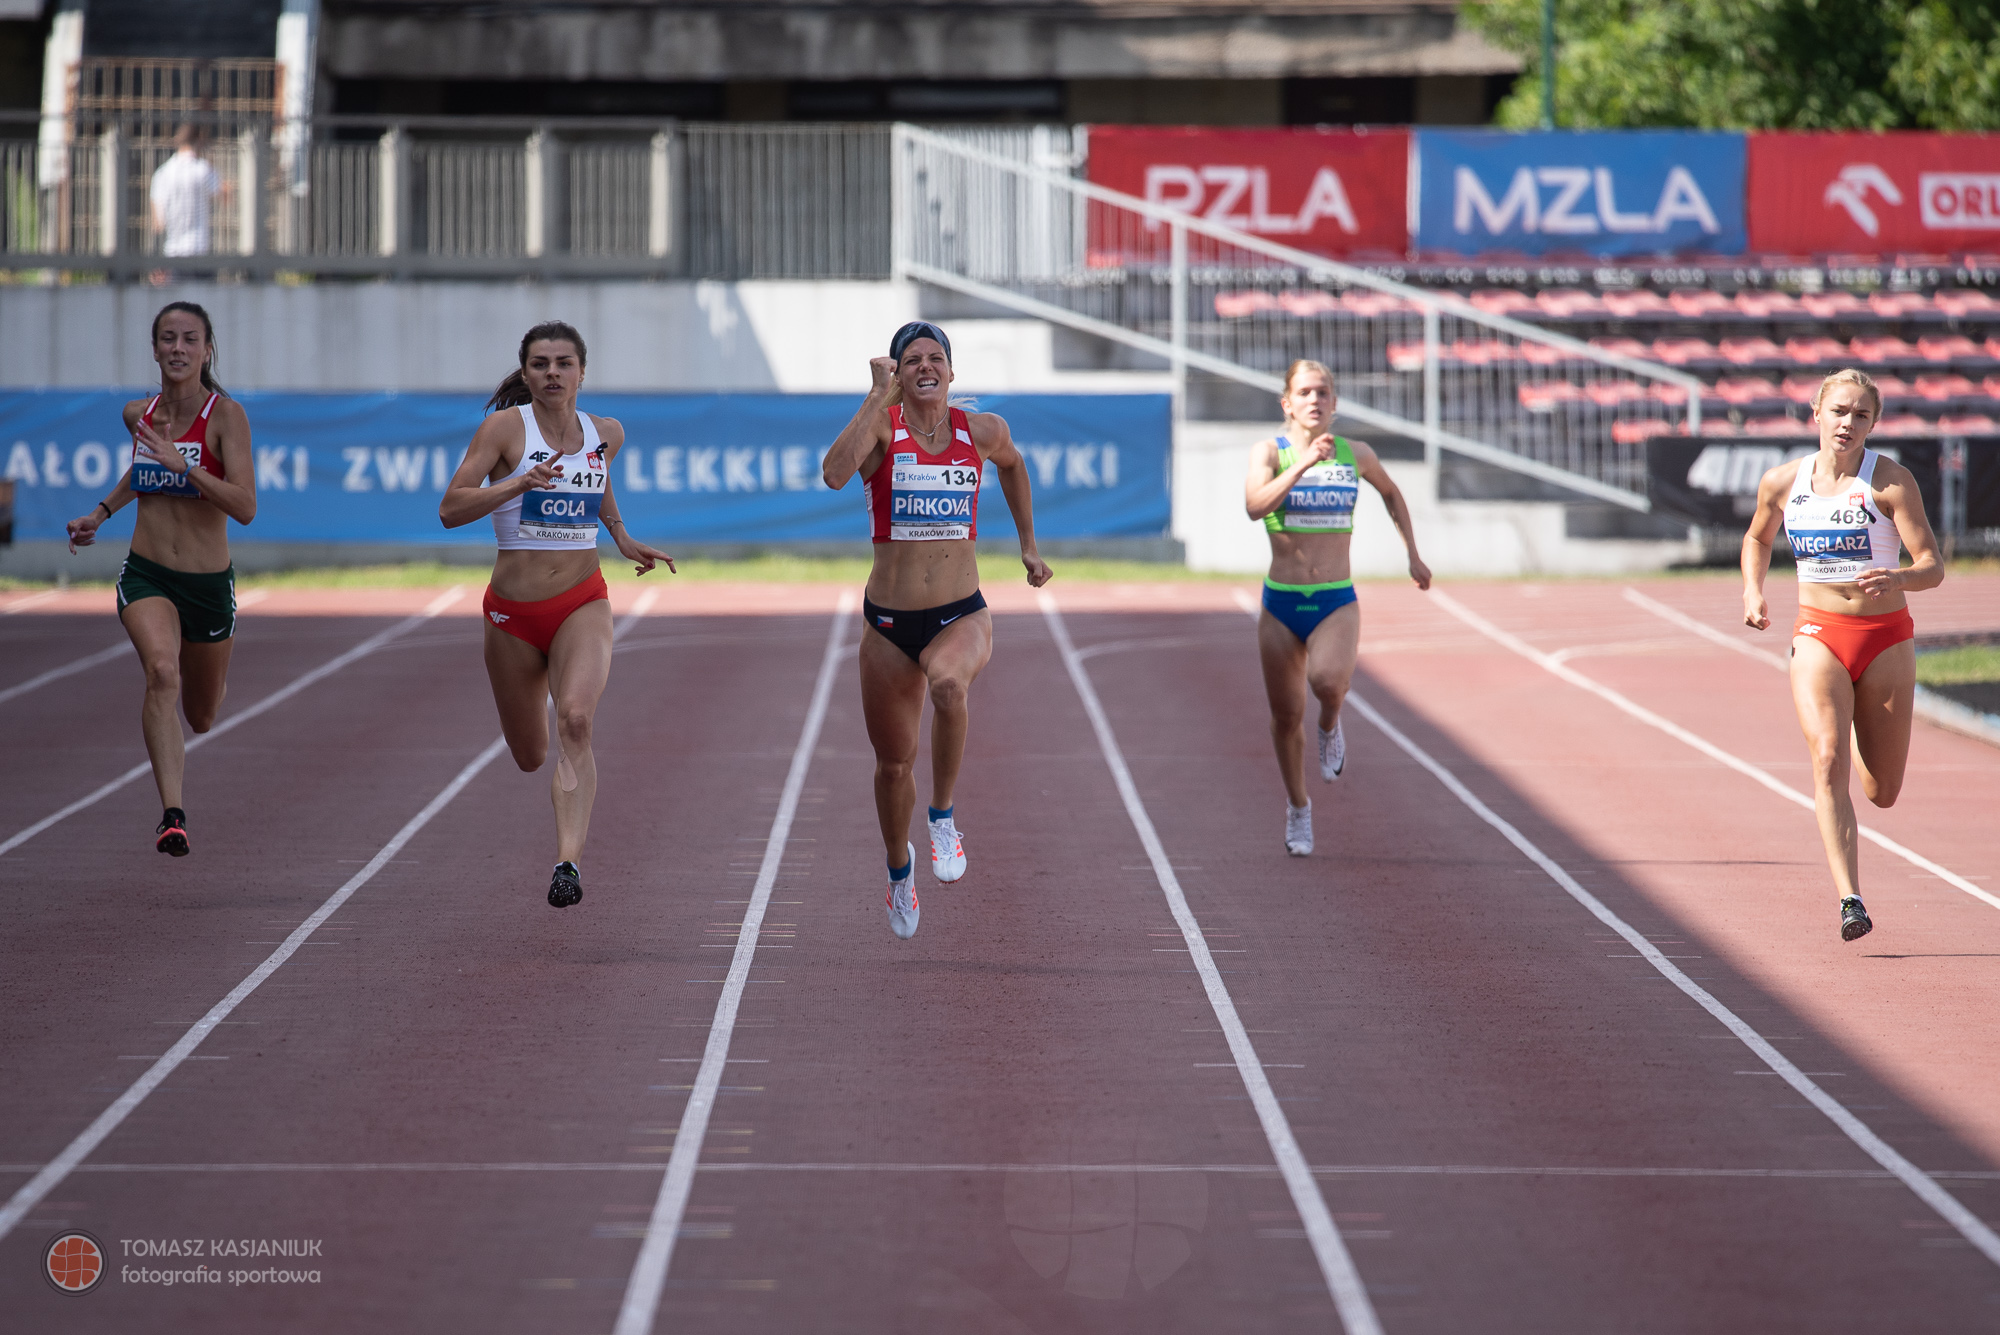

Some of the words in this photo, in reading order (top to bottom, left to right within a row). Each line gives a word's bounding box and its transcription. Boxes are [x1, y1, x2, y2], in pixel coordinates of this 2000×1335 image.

[1144, 165, 1360, 234] PZLA
[1453, 164, 1720, 235] MZLA
[528, 451, 549, 462] 4F
[138, 470, 187, 488] HAJDU
[571, 472, 604, 488] 417
[908, 473, 937, 481] Kraków
[941, 470, 977, 486] 134
[1325, 470, 1355, 482] 255
[895, 494, 970, 516] PÍRKOVÁ
[1791, 494, 1810, 505] 4F
[541, 499, 585, 517] GOLA
[1829, 509, 1868, 525] 469
[536, 530, 570, 539] KRAKÓW
[908, 529, 945, 538] KRAKÓW
[1790, 535, 1869, 556] WĘGLARZ
[1807, 566, 1837, 574] KRAKÓW
[1838, 565, 1857, 573] 2018
[489, 611, 510, 624] 4F
[1799, 623, 1823, 635] 4F
